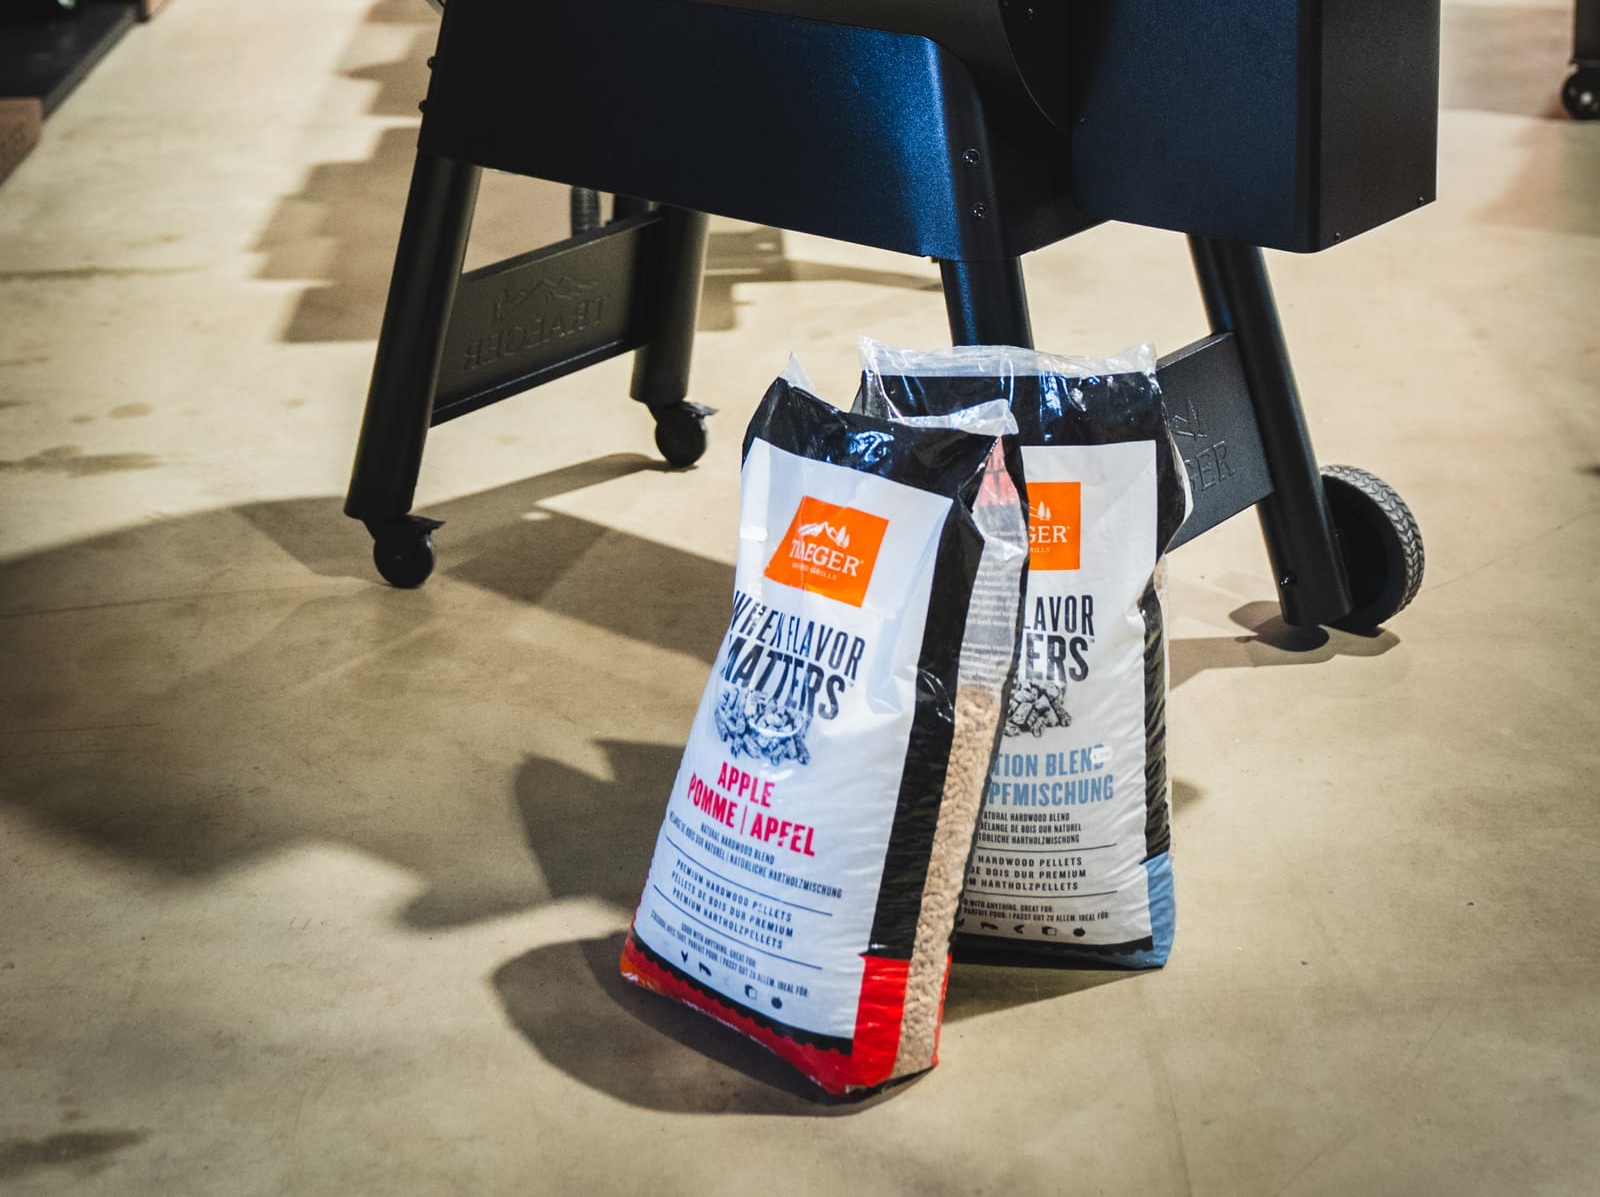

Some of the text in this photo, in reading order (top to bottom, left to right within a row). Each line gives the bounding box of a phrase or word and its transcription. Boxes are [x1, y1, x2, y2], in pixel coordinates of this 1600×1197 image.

[1024, 595, 1095, 636] AVOR
[786, 616, 866, 681] FLAVOR
[1025, 633, 1089, 682] ERS
[717, 761, 775, 808] APPLE
[988, 774, 1114, 807] PFMISCHUNG
[687, 772, 815, 857] POMME APFEL
[983, 811, 1070, 822] ATURAL HARDWOOD BLEND
[1010, 824, 1019, 833] DE
[1021, 824, 1037, 833] BOIS
[1038, 824, 1052, 833] DUR
[1053, 822, 1082, 833] NATUREL
[721, 834, 753, 857] HARDWOOD
[754, 848, 775, 865] BLEND
[1011, 834, 1080, 845] HARTHOLZMISCHUNG
[978, 855, 1082, 867] HARDWOOD PELLETS
[986, 868, 1010, 878] BOIS
[1014, 870, 1034, 879] DUR
[1039, 869, 1087, 879] PREMIUM
[676, 859, 792, 922] PREMIUM HARDWOOD PELLETS
[768, 868, 843, 899] HARTHOLZMISCHUNG
[981, 880, 1079, 891] HARTHOLZPELLETS
[671, 870, 793, 938] PELLETS DE BOIS DUR PREMIUM
[672, 887, 701, 913] PREMIUM
[703, 906, 783, 950] HARTHOLZPELLETS
